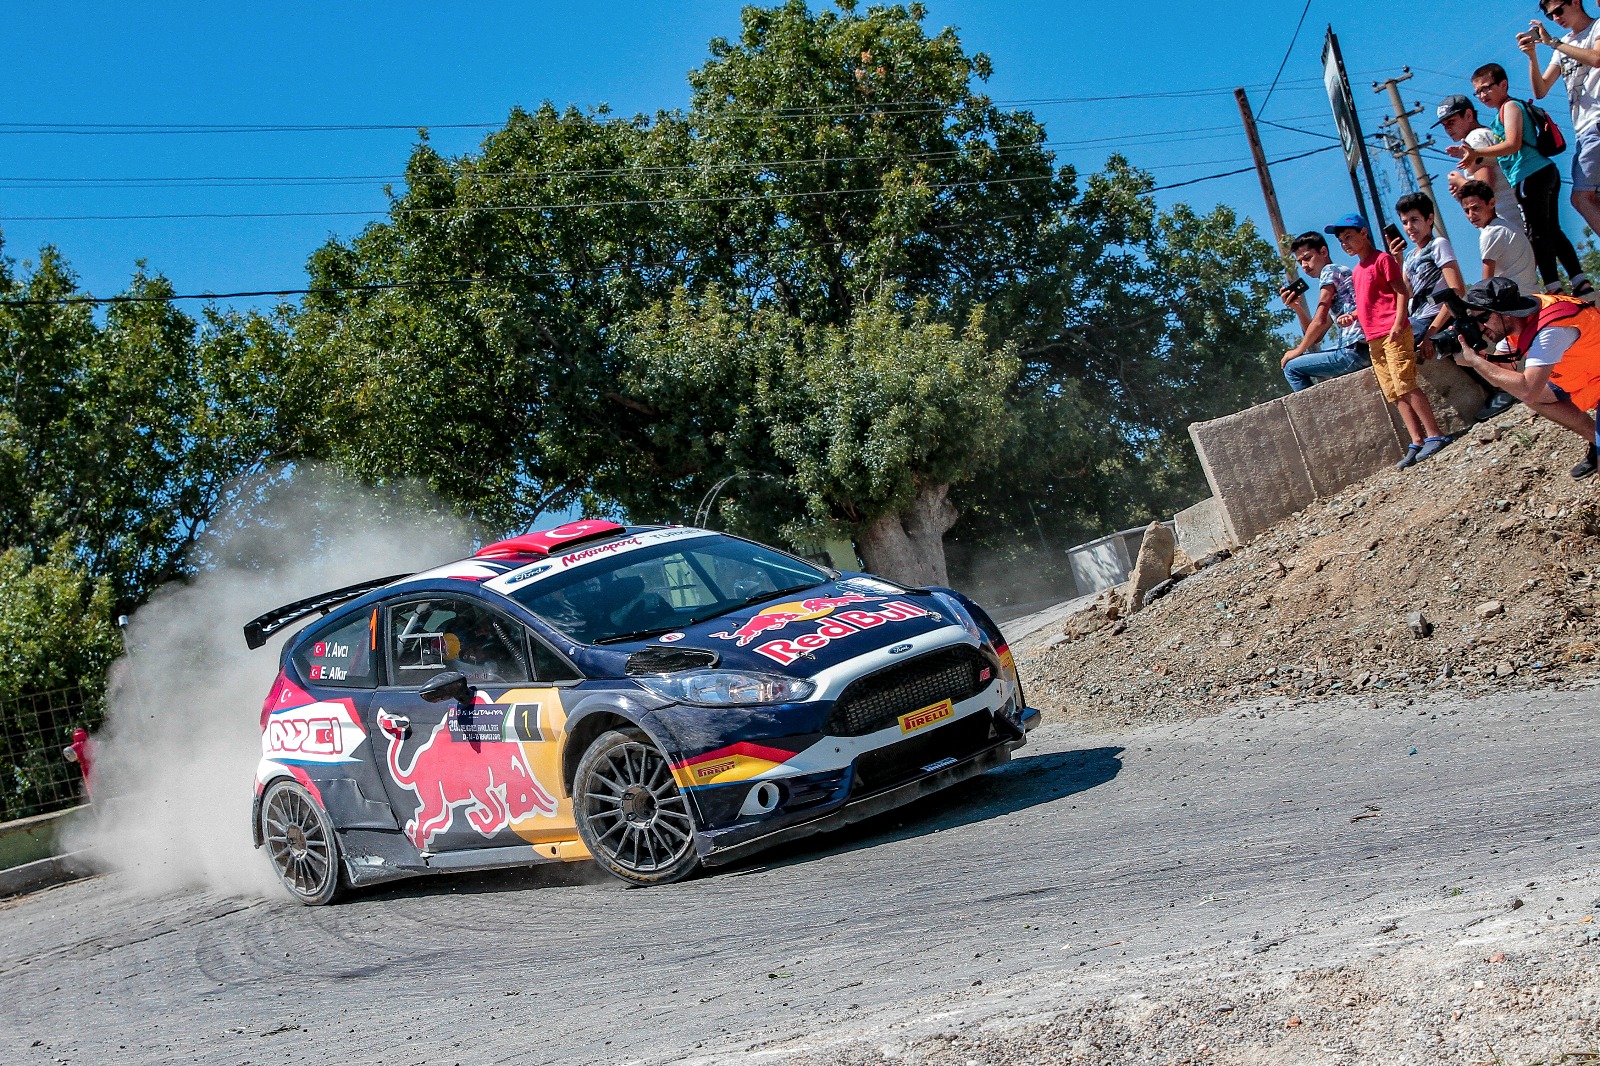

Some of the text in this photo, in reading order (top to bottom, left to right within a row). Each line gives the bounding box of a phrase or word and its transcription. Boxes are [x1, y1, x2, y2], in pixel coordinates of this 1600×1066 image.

[562, 536, 643, 567] Motorsport
[370, 608, 377, 651] 1
[755, 600, 927, 665] Red Bull
[325, 641, 331, 658] Y.
[319, 666, 328, 680] E.
[521, 709, 532, 738] 1
[904, 703, 949, 731] PIRELLI
